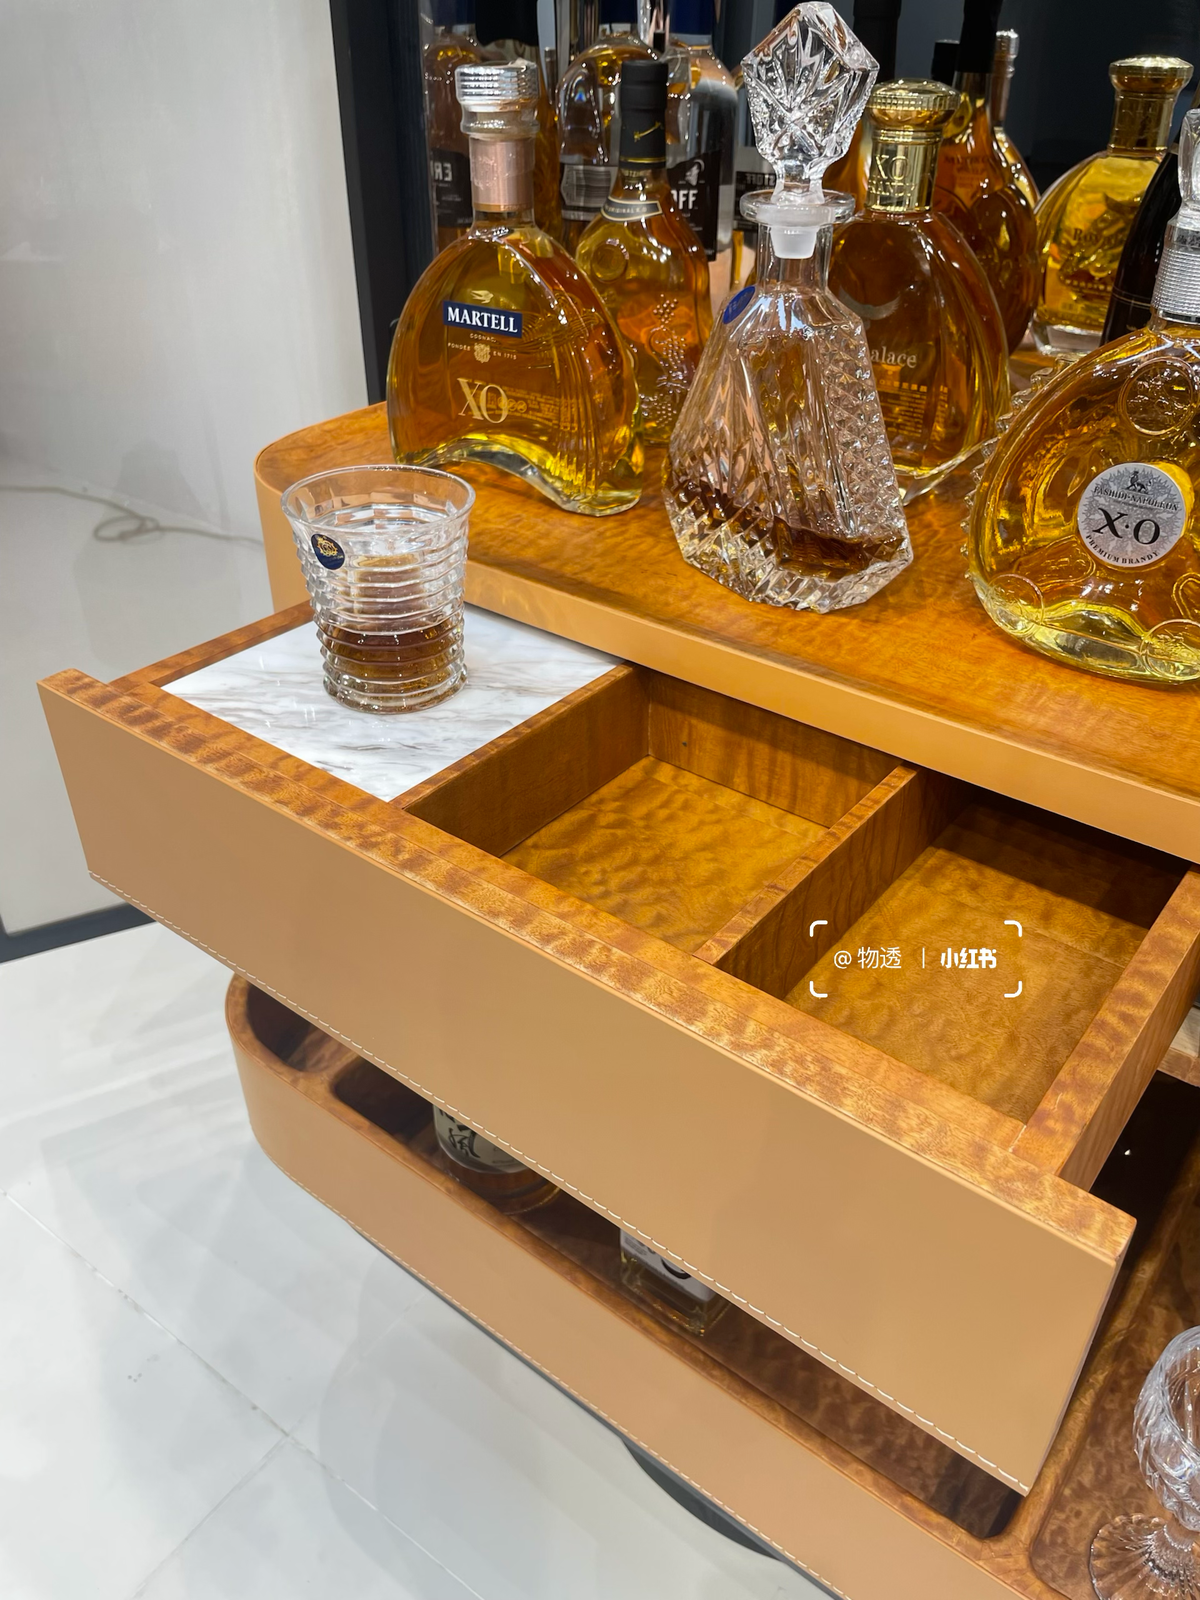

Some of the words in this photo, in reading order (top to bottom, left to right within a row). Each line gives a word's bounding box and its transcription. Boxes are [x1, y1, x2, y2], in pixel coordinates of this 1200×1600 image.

[875, 155, 909, 180] XO
[447, 306, 518, 333] MARTELL
[504, 352, 517, 360] 1715
[870, 346, 917, 369] alace
[457, 377, 509, 424] XO
[1086, 534, 1120, 563] PREMIUM
[1121, 550, 1160, 564] BRANDY
